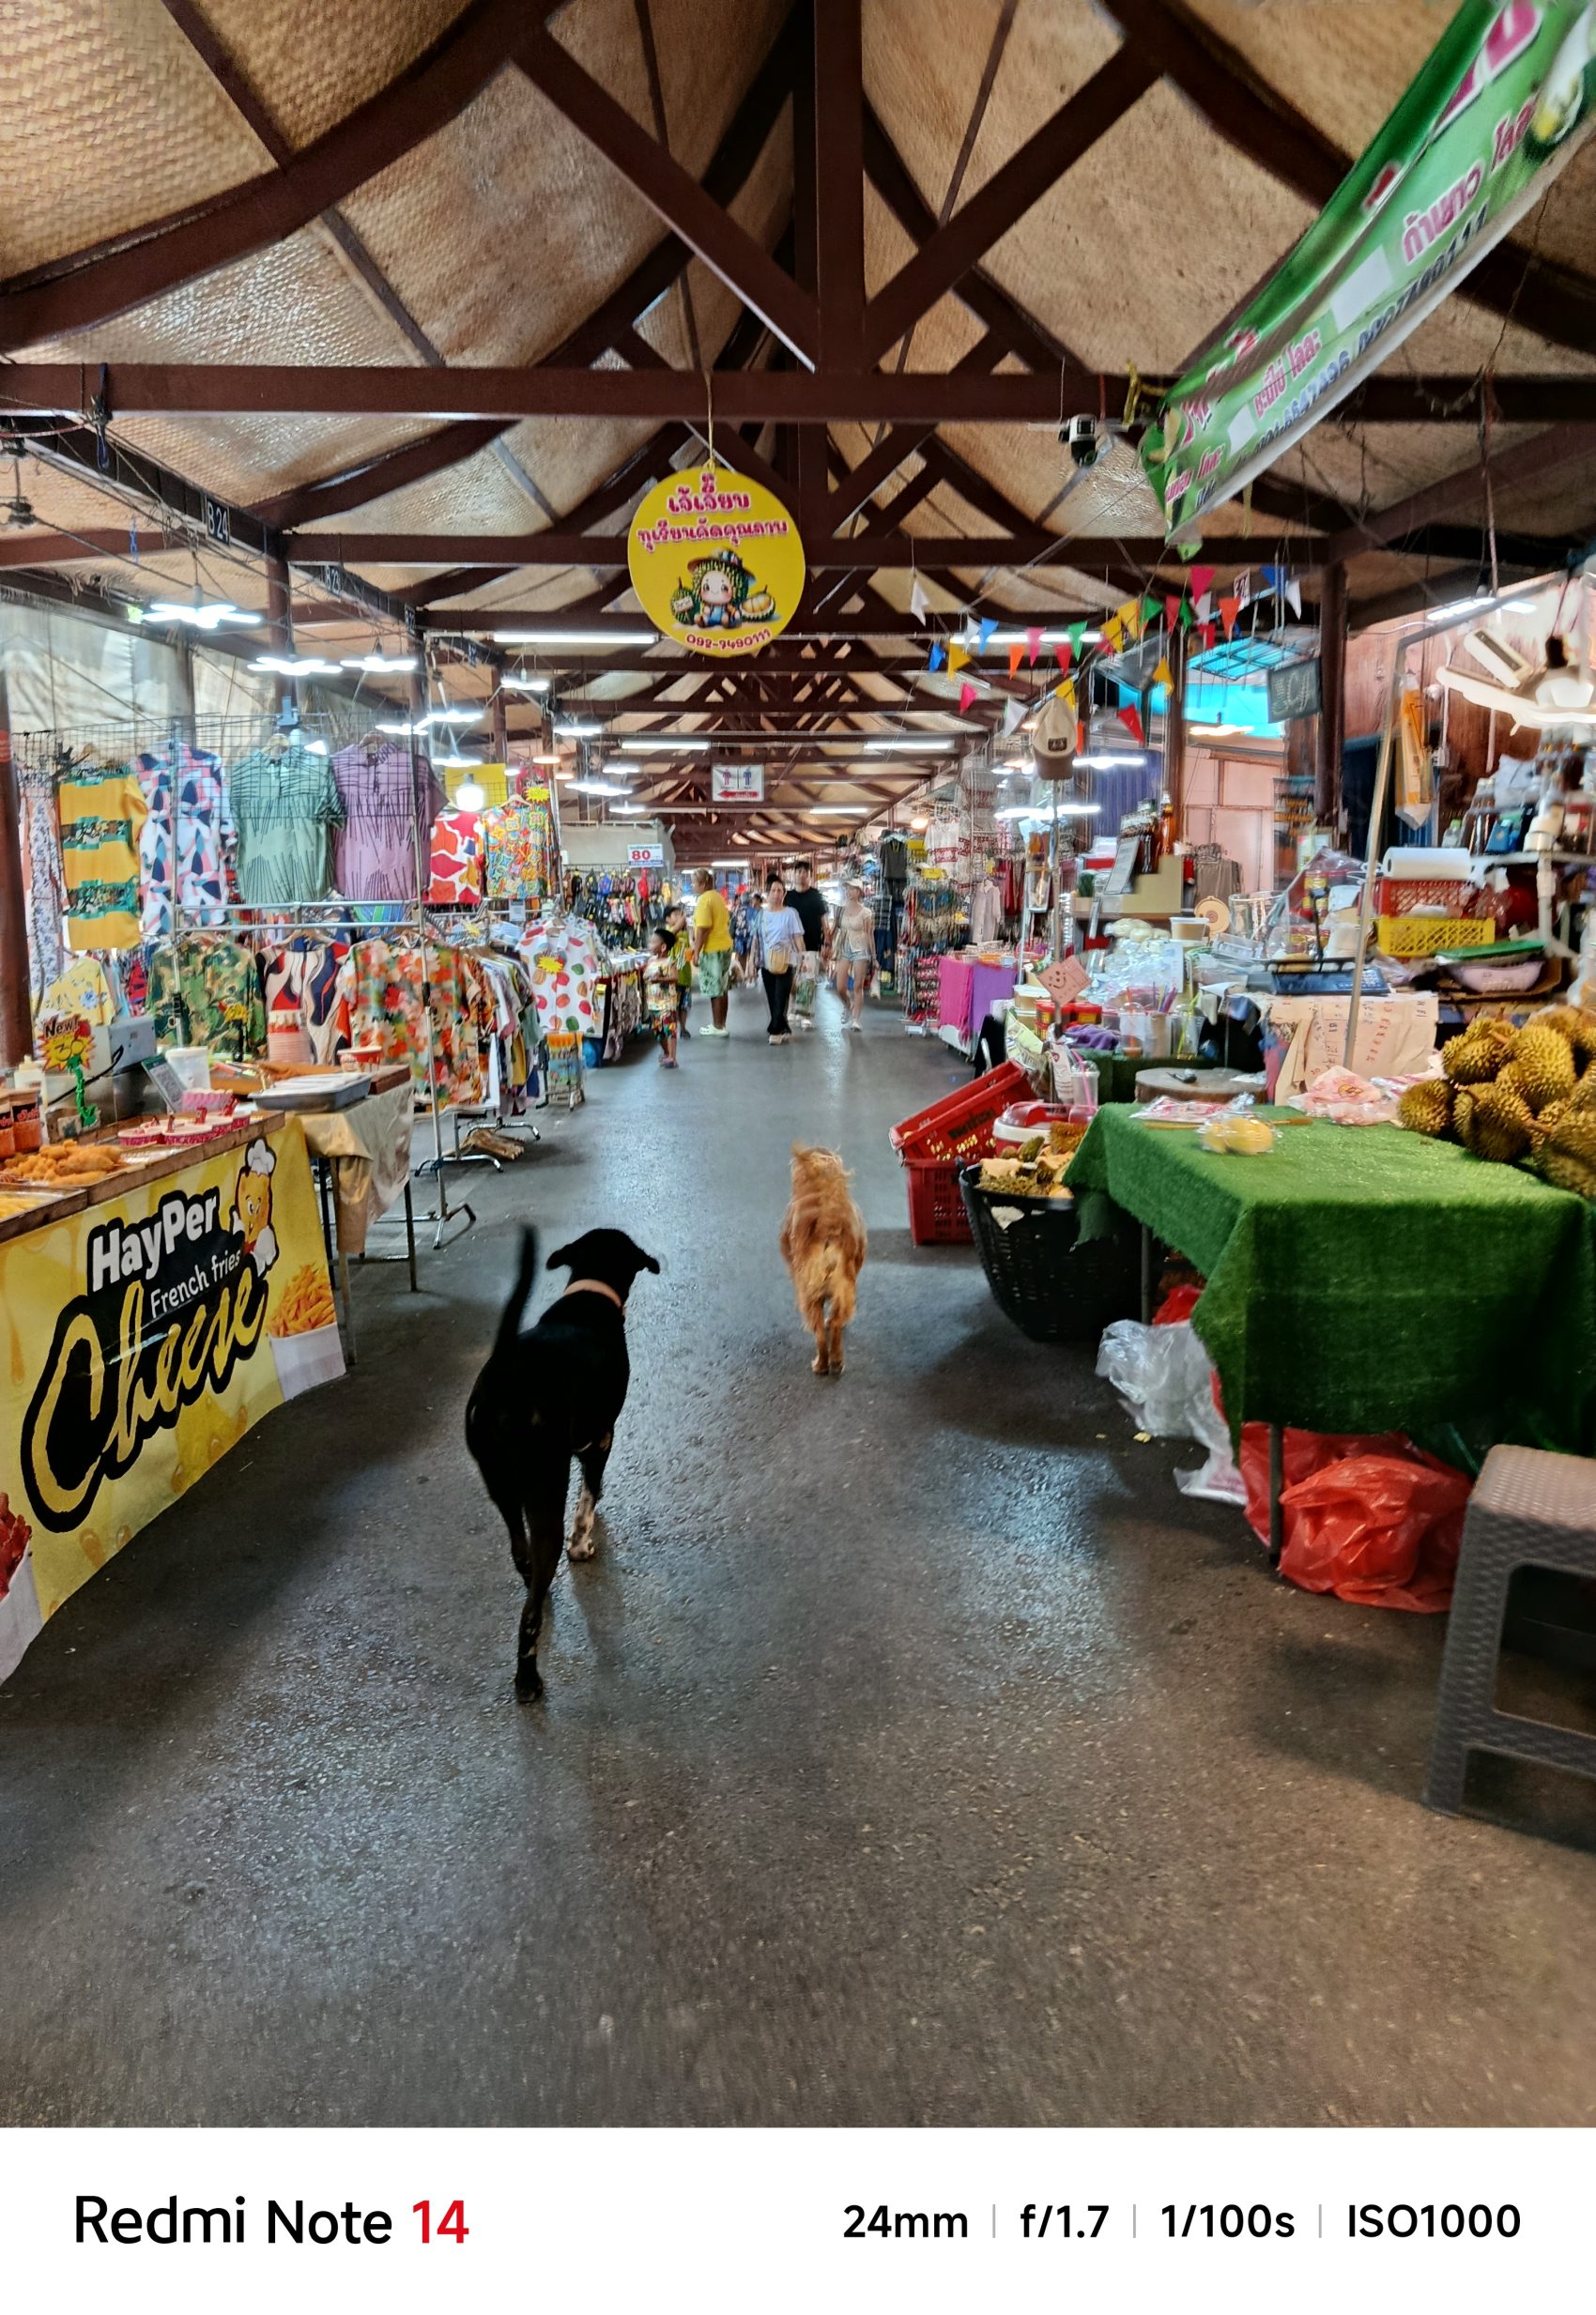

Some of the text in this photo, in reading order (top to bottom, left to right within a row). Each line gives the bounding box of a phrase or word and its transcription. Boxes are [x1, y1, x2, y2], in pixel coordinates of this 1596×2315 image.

[207, 500, 229, 543] B 24
[686, 629, 771, 650] 092-7490111
[632, 850, 651, 861] 80
[45, 1015, 81, 1038] New!
[92, 1195, 219, 1292] HayPer
[150, 1247, 242, 1318] French fries
[32, 1267, 268, 1514] Cheese
